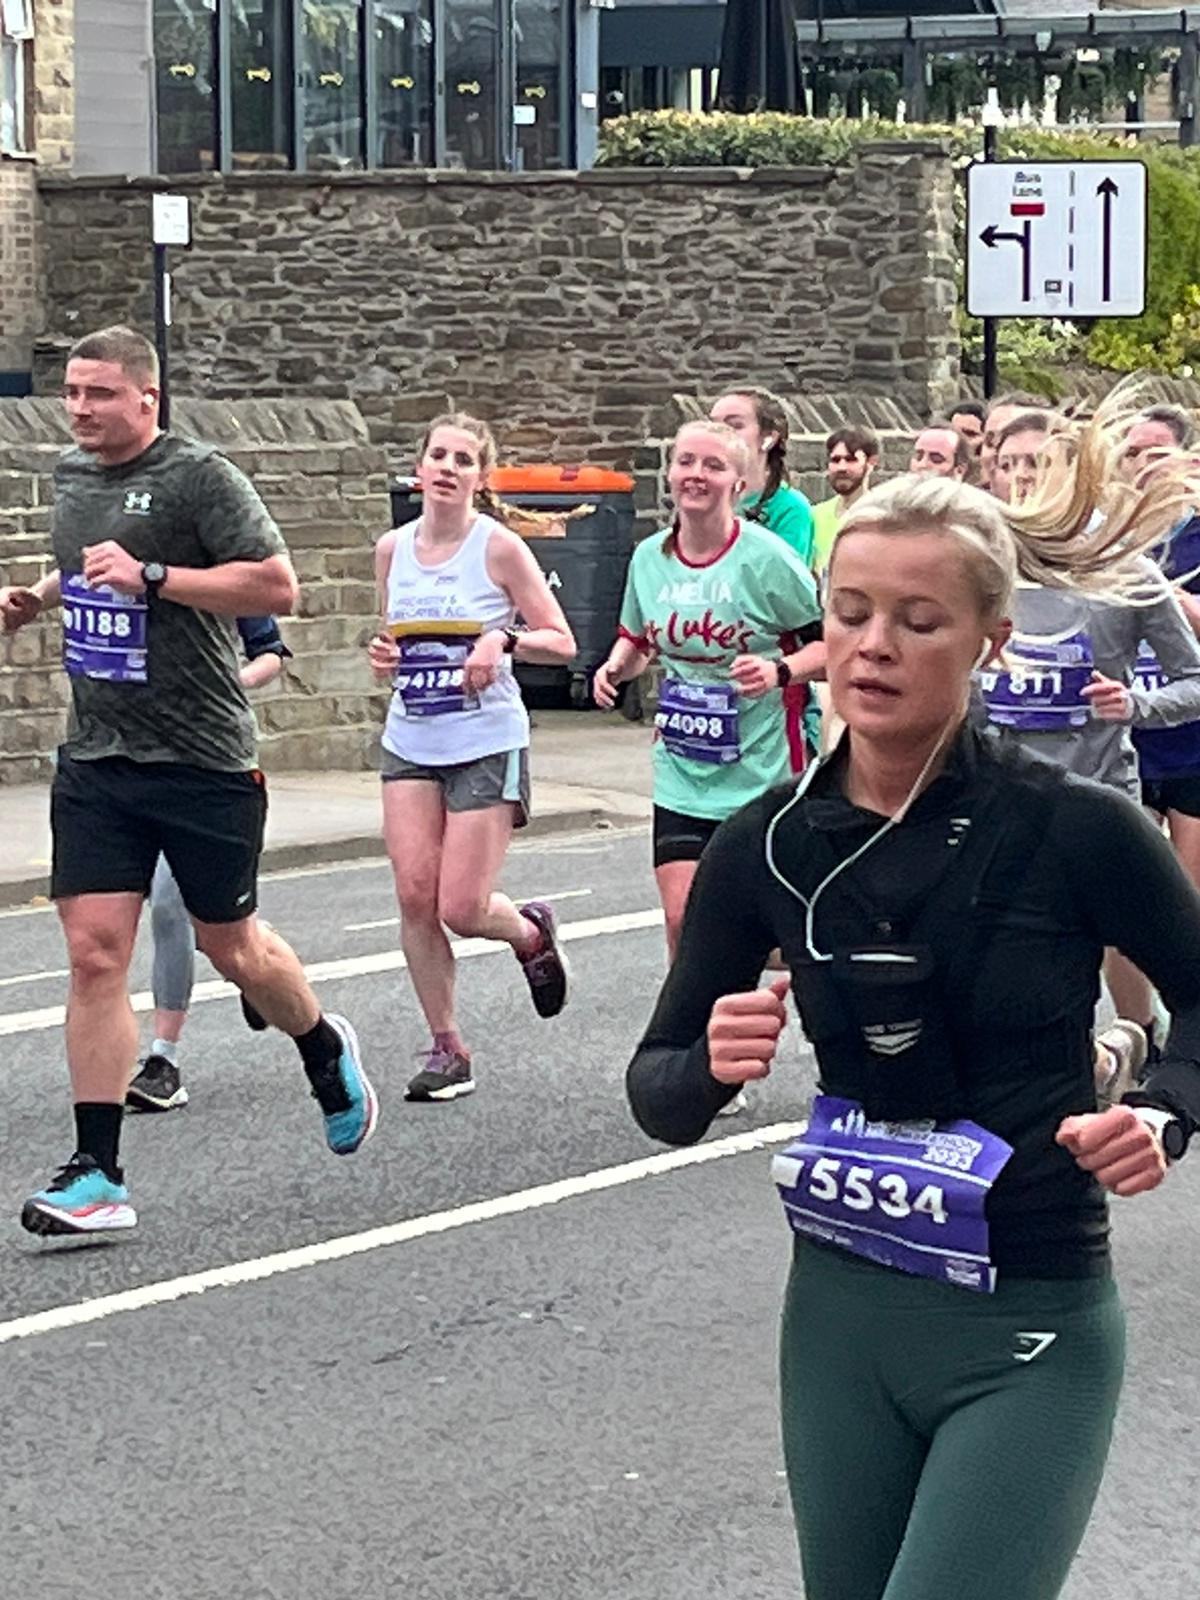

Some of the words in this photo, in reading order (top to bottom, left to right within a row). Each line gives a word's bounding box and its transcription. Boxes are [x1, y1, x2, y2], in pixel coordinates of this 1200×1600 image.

[1014, 171, 1042, 183] Bus
[656, 581, 733, 604] AMELIA
[73, 607, 131, 637] 1188
[666, 608, 756, 653] Luke's
[668, 713, 723, 738] 4098
[809, 1156, 949, 1224] 5534
